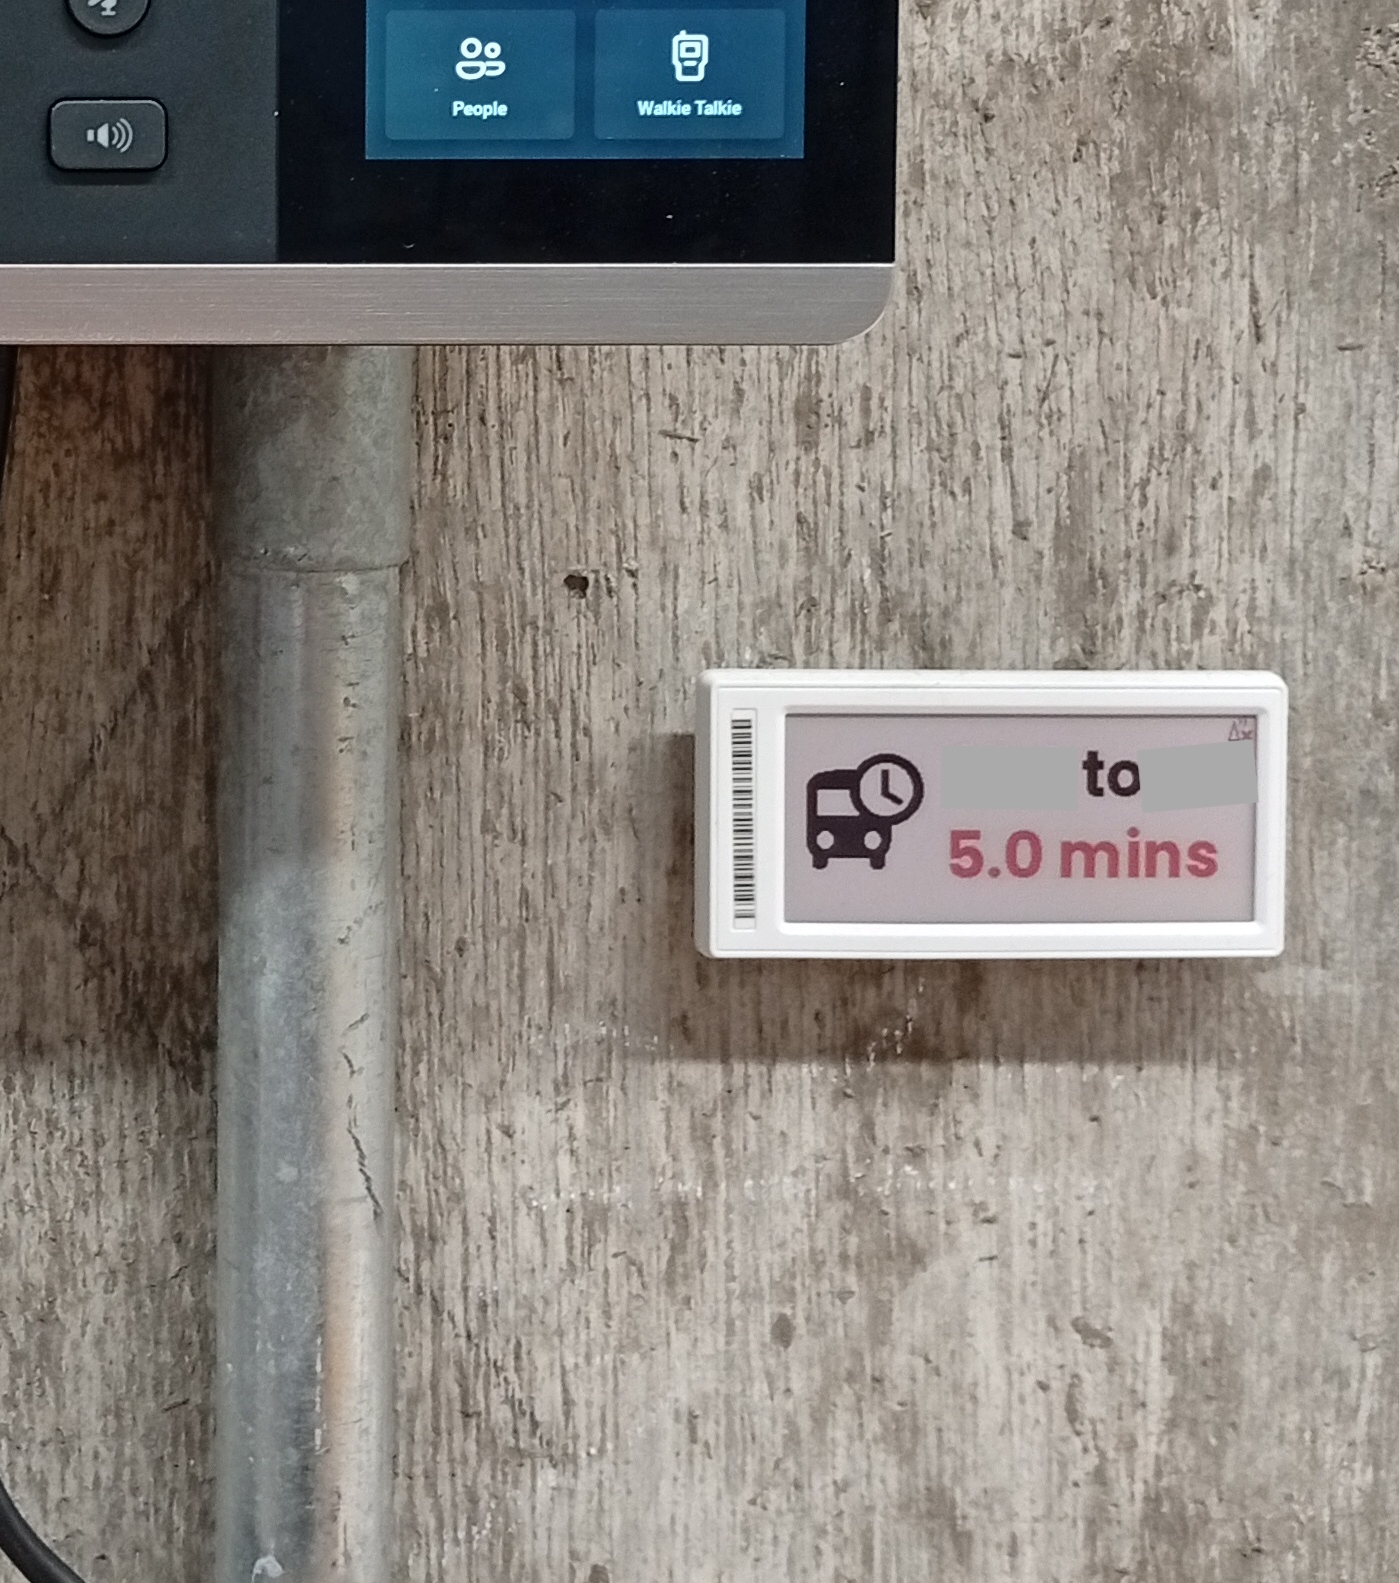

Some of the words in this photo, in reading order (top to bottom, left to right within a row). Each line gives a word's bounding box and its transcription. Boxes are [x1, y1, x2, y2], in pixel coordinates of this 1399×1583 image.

[452, 101, 508, 119] People
[638, 100, 691, 117] Walkie
[695, 100, 742, 117] Talkie
[1082, 749, 1140, 797] to
[949, 829, 1043, 879] 5.0
[1060, 826, 1219, 879] mins
